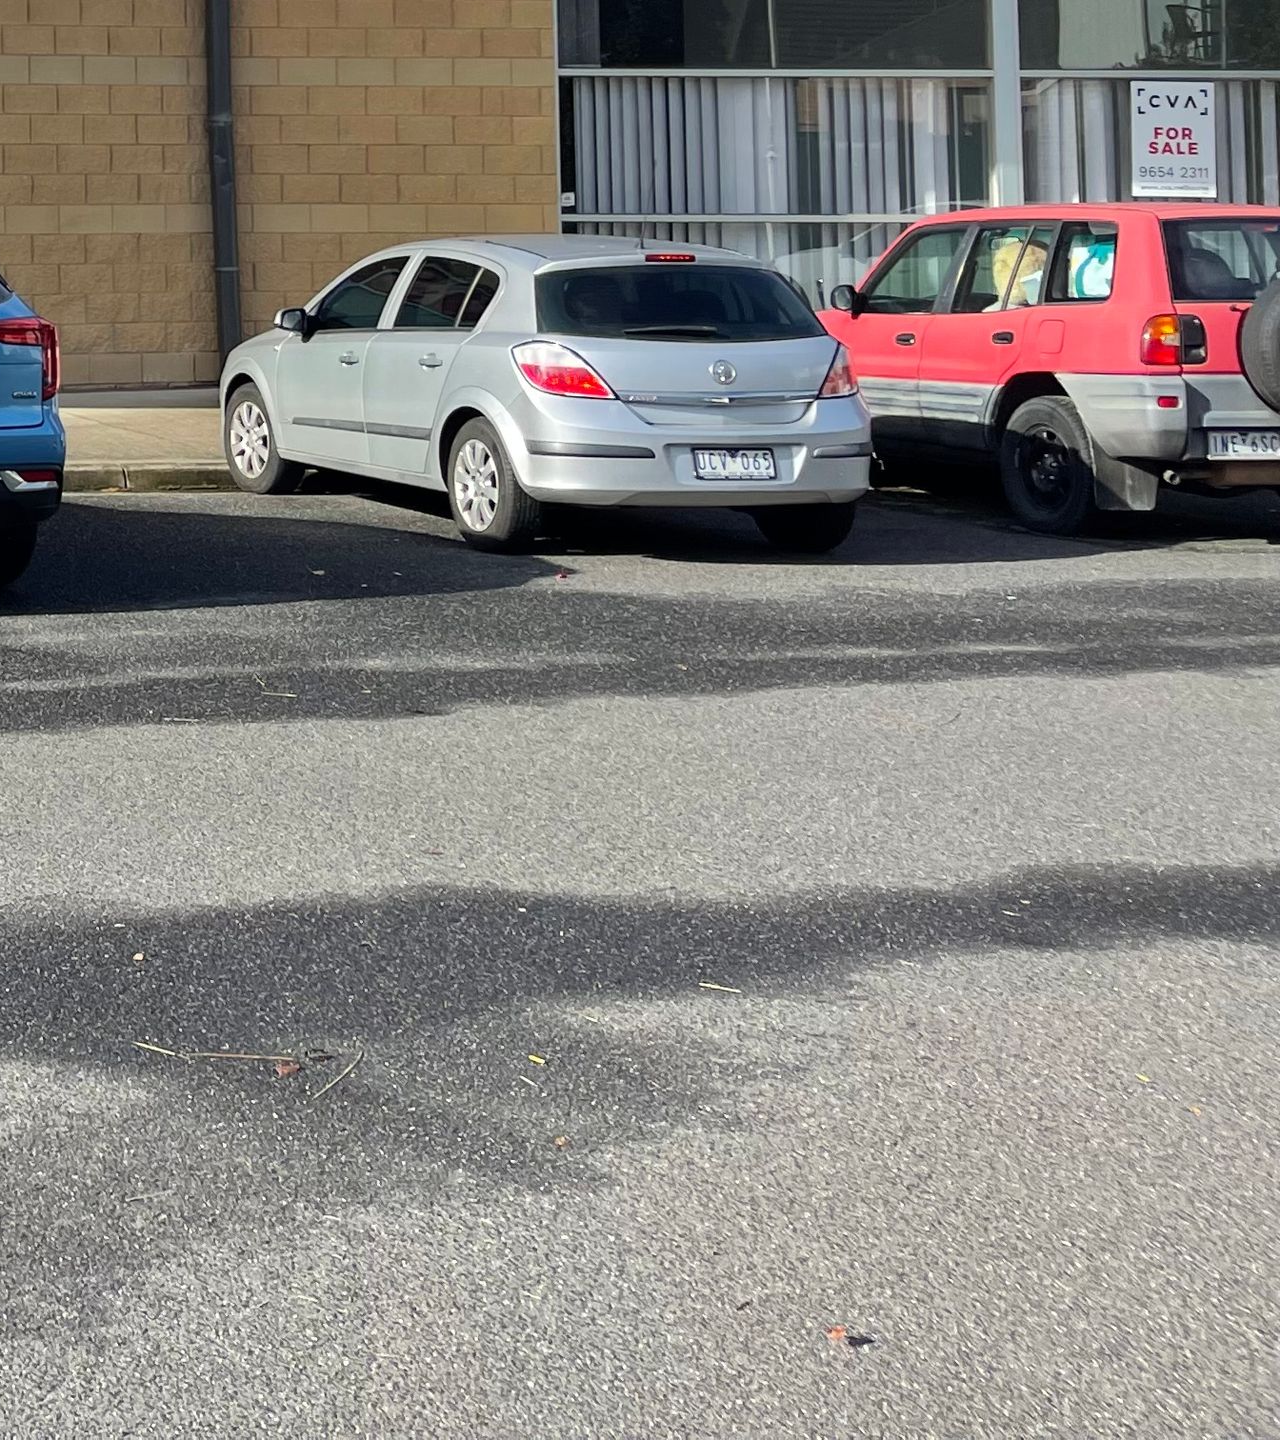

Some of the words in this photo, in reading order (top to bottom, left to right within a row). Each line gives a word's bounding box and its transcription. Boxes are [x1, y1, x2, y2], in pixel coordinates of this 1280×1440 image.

[1153, 127, 1193, 140] FOR
[1148, 142, 1199, 155] SALE
[1139, 166, 1174, 178] 9654
[1180, 166, 1209, 178] 2311
